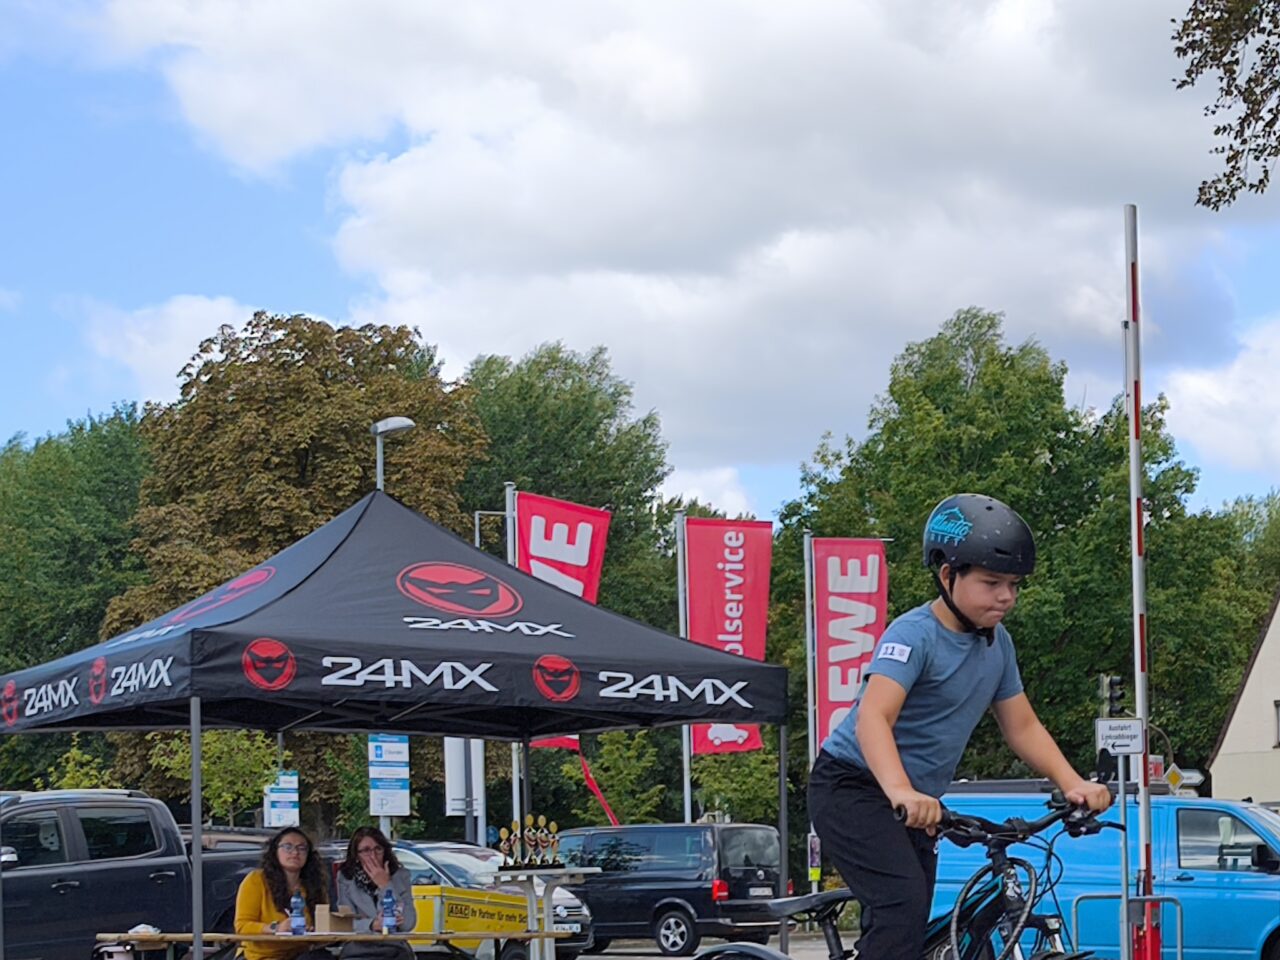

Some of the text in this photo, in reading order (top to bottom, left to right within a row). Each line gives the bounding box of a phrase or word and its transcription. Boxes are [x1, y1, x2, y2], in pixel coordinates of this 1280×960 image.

[402, 616, 576, 638] 24MX
[111, 656, 174, 696] 24MX
[321, 656, 500, 692] 24MX
[598, 670, 754, 709] 24MX
[24, 676, 80, 716] 24MX
[449, 904, 469, 916] ADAC
